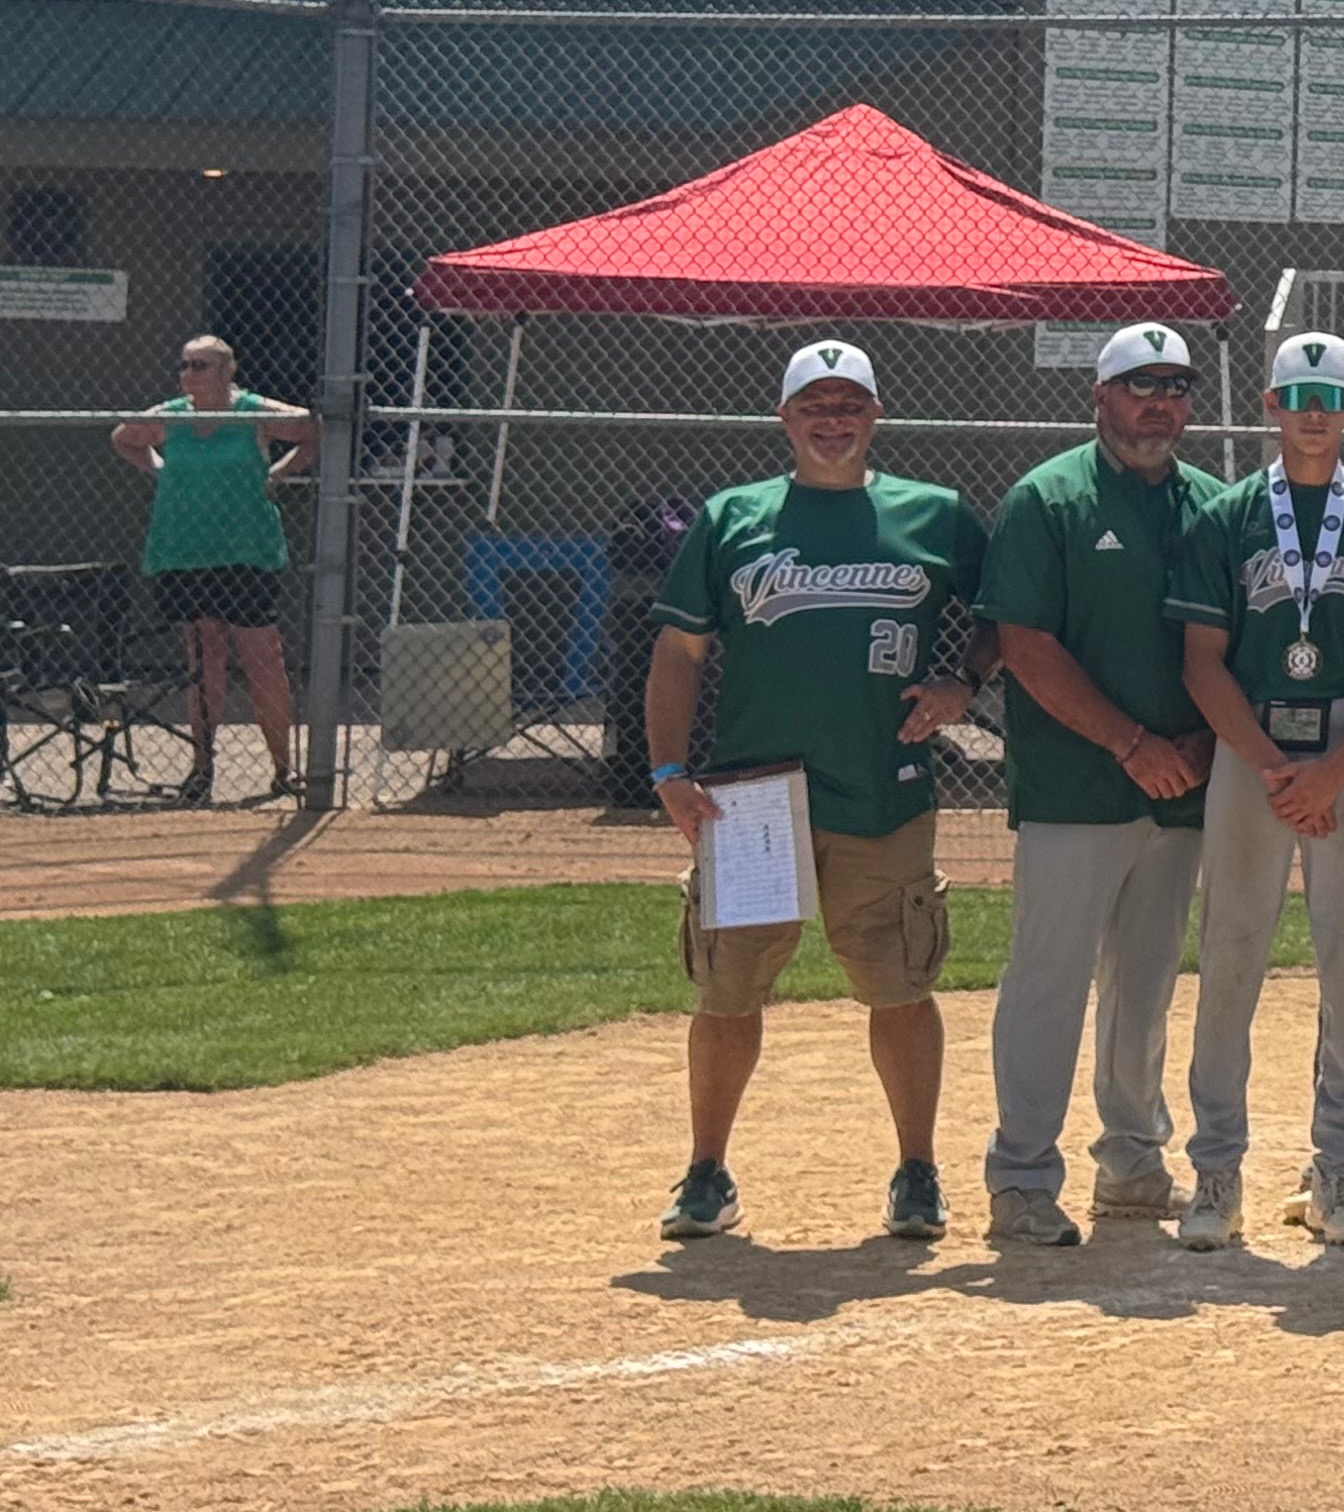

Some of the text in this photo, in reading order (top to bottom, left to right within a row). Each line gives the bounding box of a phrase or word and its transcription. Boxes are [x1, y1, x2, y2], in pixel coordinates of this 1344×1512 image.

[1144, 330, 1167, 354] V
[817, 348, 843, 370] V
[1302, 343, 1327, 367] V
[731, 547, 931, 620] Vincennes
[868, 619, 918, 678] 20
